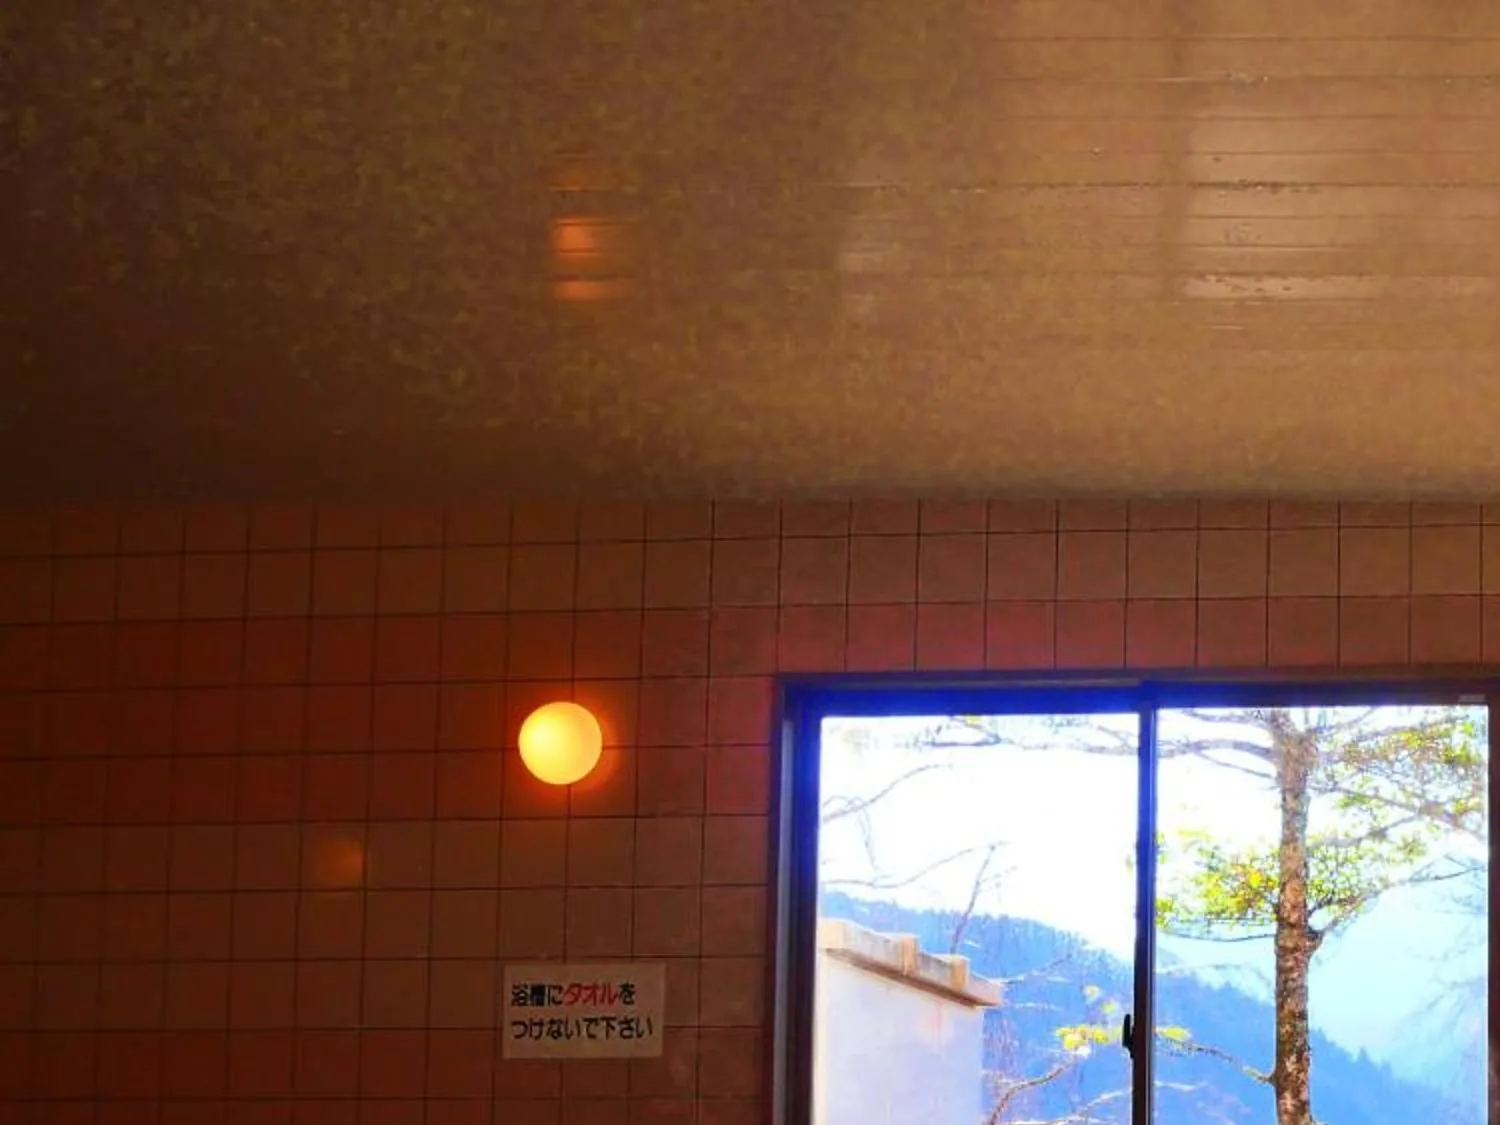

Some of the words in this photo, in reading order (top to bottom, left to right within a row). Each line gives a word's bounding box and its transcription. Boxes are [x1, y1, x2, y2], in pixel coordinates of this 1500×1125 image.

[511, 983, 636, 1007] 浴槽にタオルを
[511, 1016, 653, 1040] つけないで下さい
